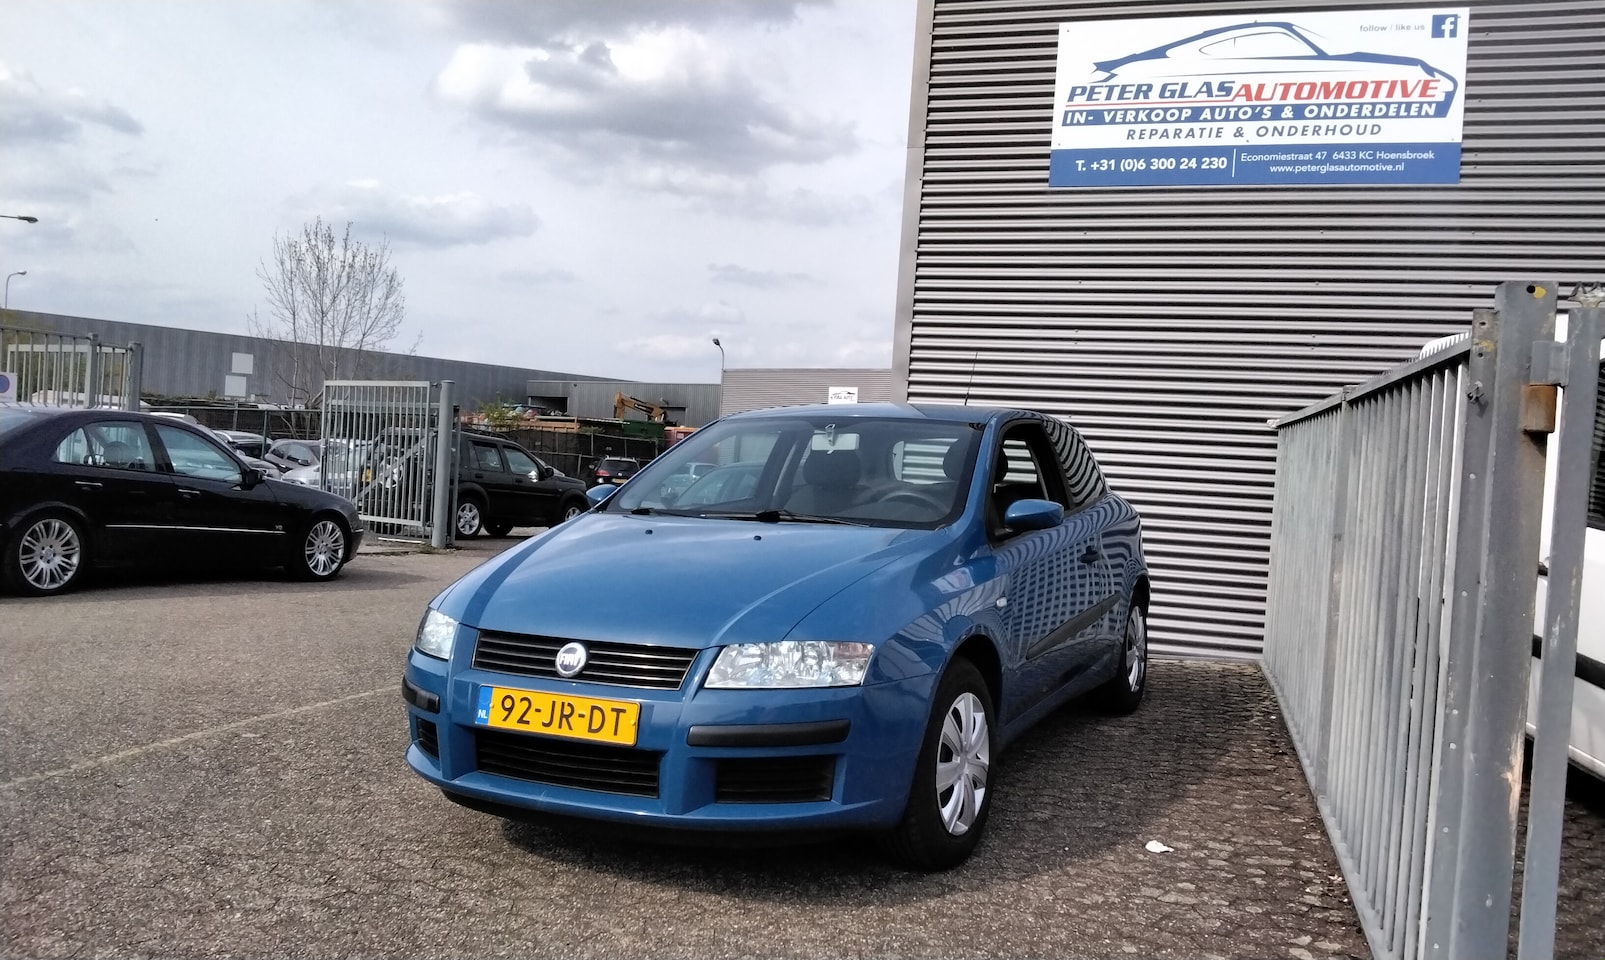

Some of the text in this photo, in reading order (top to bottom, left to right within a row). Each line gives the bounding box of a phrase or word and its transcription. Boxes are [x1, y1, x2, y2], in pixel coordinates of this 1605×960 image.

[1360, 24, 1387, 32] follow
[1396, 23, 1411, 31] like
[1067, 83, 1153, 102] PETER
[1066, 103, 1437, 124] IN- VERKOOP AUTO'S & ONDERDELEN
[1126, 124, 1382, 140] REPARATIE & ONDERHOUD
[1241, 150, 1435, 162] Economiestraat 47 6433 KC Hoensbroek
[1075, 157, 1227, 172] T. +31 (0)6 300 24 230
[1270, 162, 1405, 174] www.peterglasautomotive.nl
[559, 654, 580, 666] FIAT
[478, 694, 627, 736] NL 92-JR-DT
